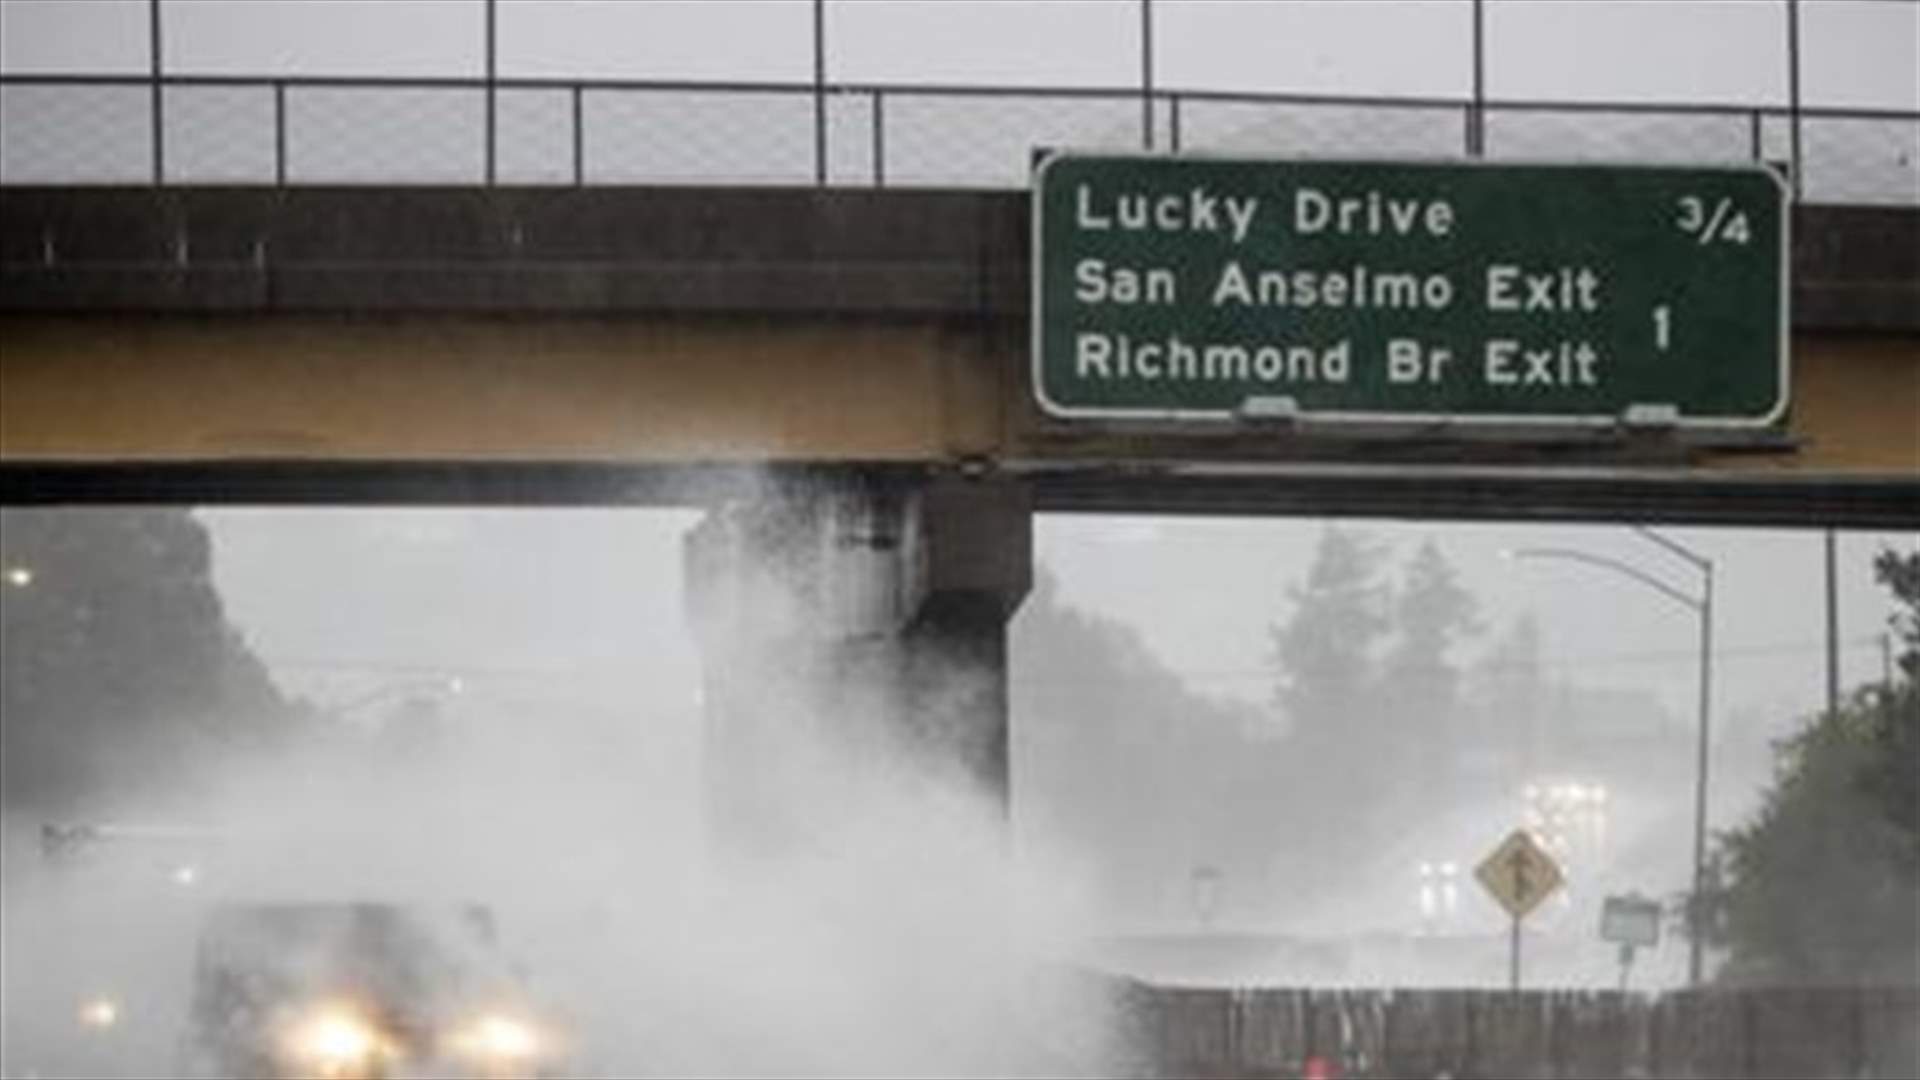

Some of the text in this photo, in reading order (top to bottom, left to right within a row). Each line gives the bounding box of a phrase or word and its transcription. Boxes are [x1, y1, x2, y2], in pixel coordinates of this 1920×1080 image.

[1077, 186, 1455, 242] Lucky Drive
[1075, 259, 1598, 312] San Anselmo Exit
[1652, 306, 1670, 348] 1
[1076, 333, 1598, 386] Richmond Br Exit
